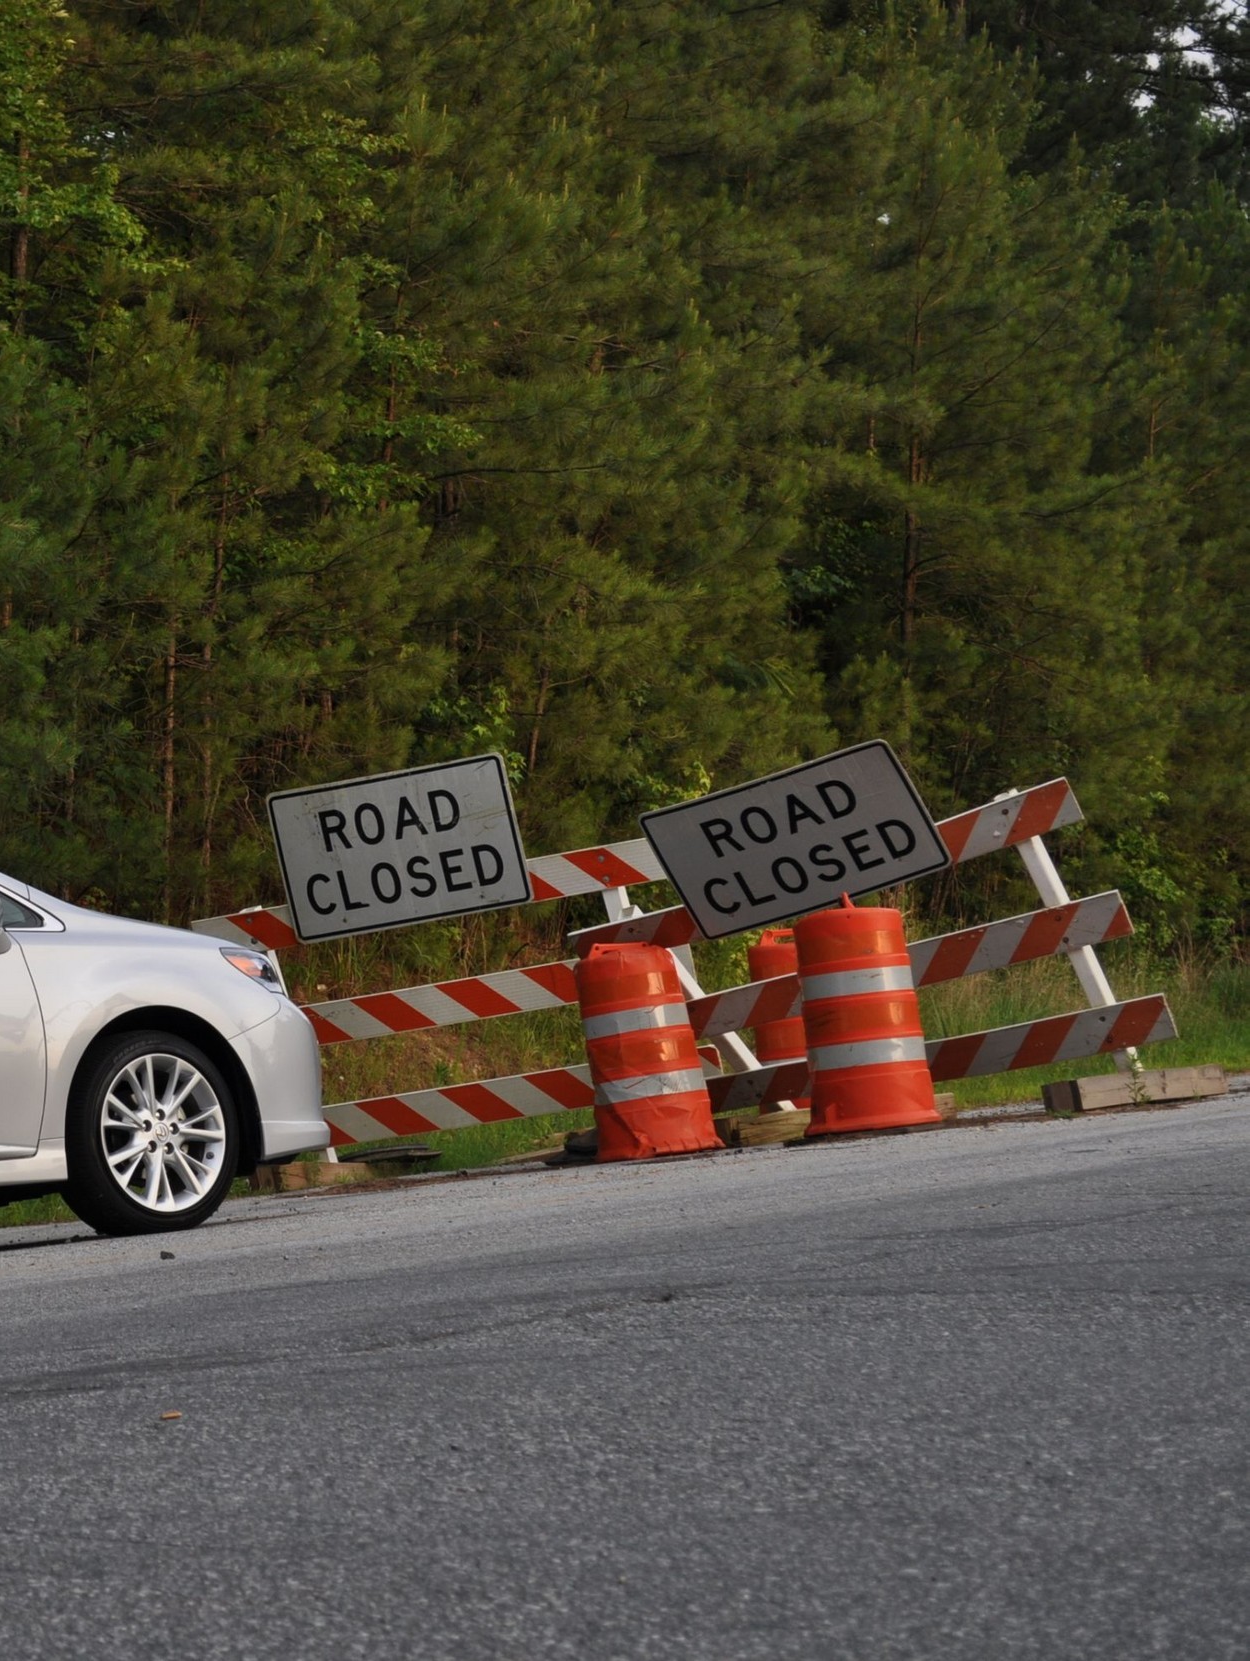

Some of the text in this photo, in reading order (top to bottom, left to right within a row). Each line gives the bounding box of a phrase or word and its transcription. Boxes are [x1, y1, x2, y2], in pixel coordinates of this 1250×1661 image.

[318, 788, 461, 852] ROAD
[699, 779, 857, 857] ROAD
[306, 844, 504, 915] CLOSED
[703, 819, 917, 918] CLOSED
